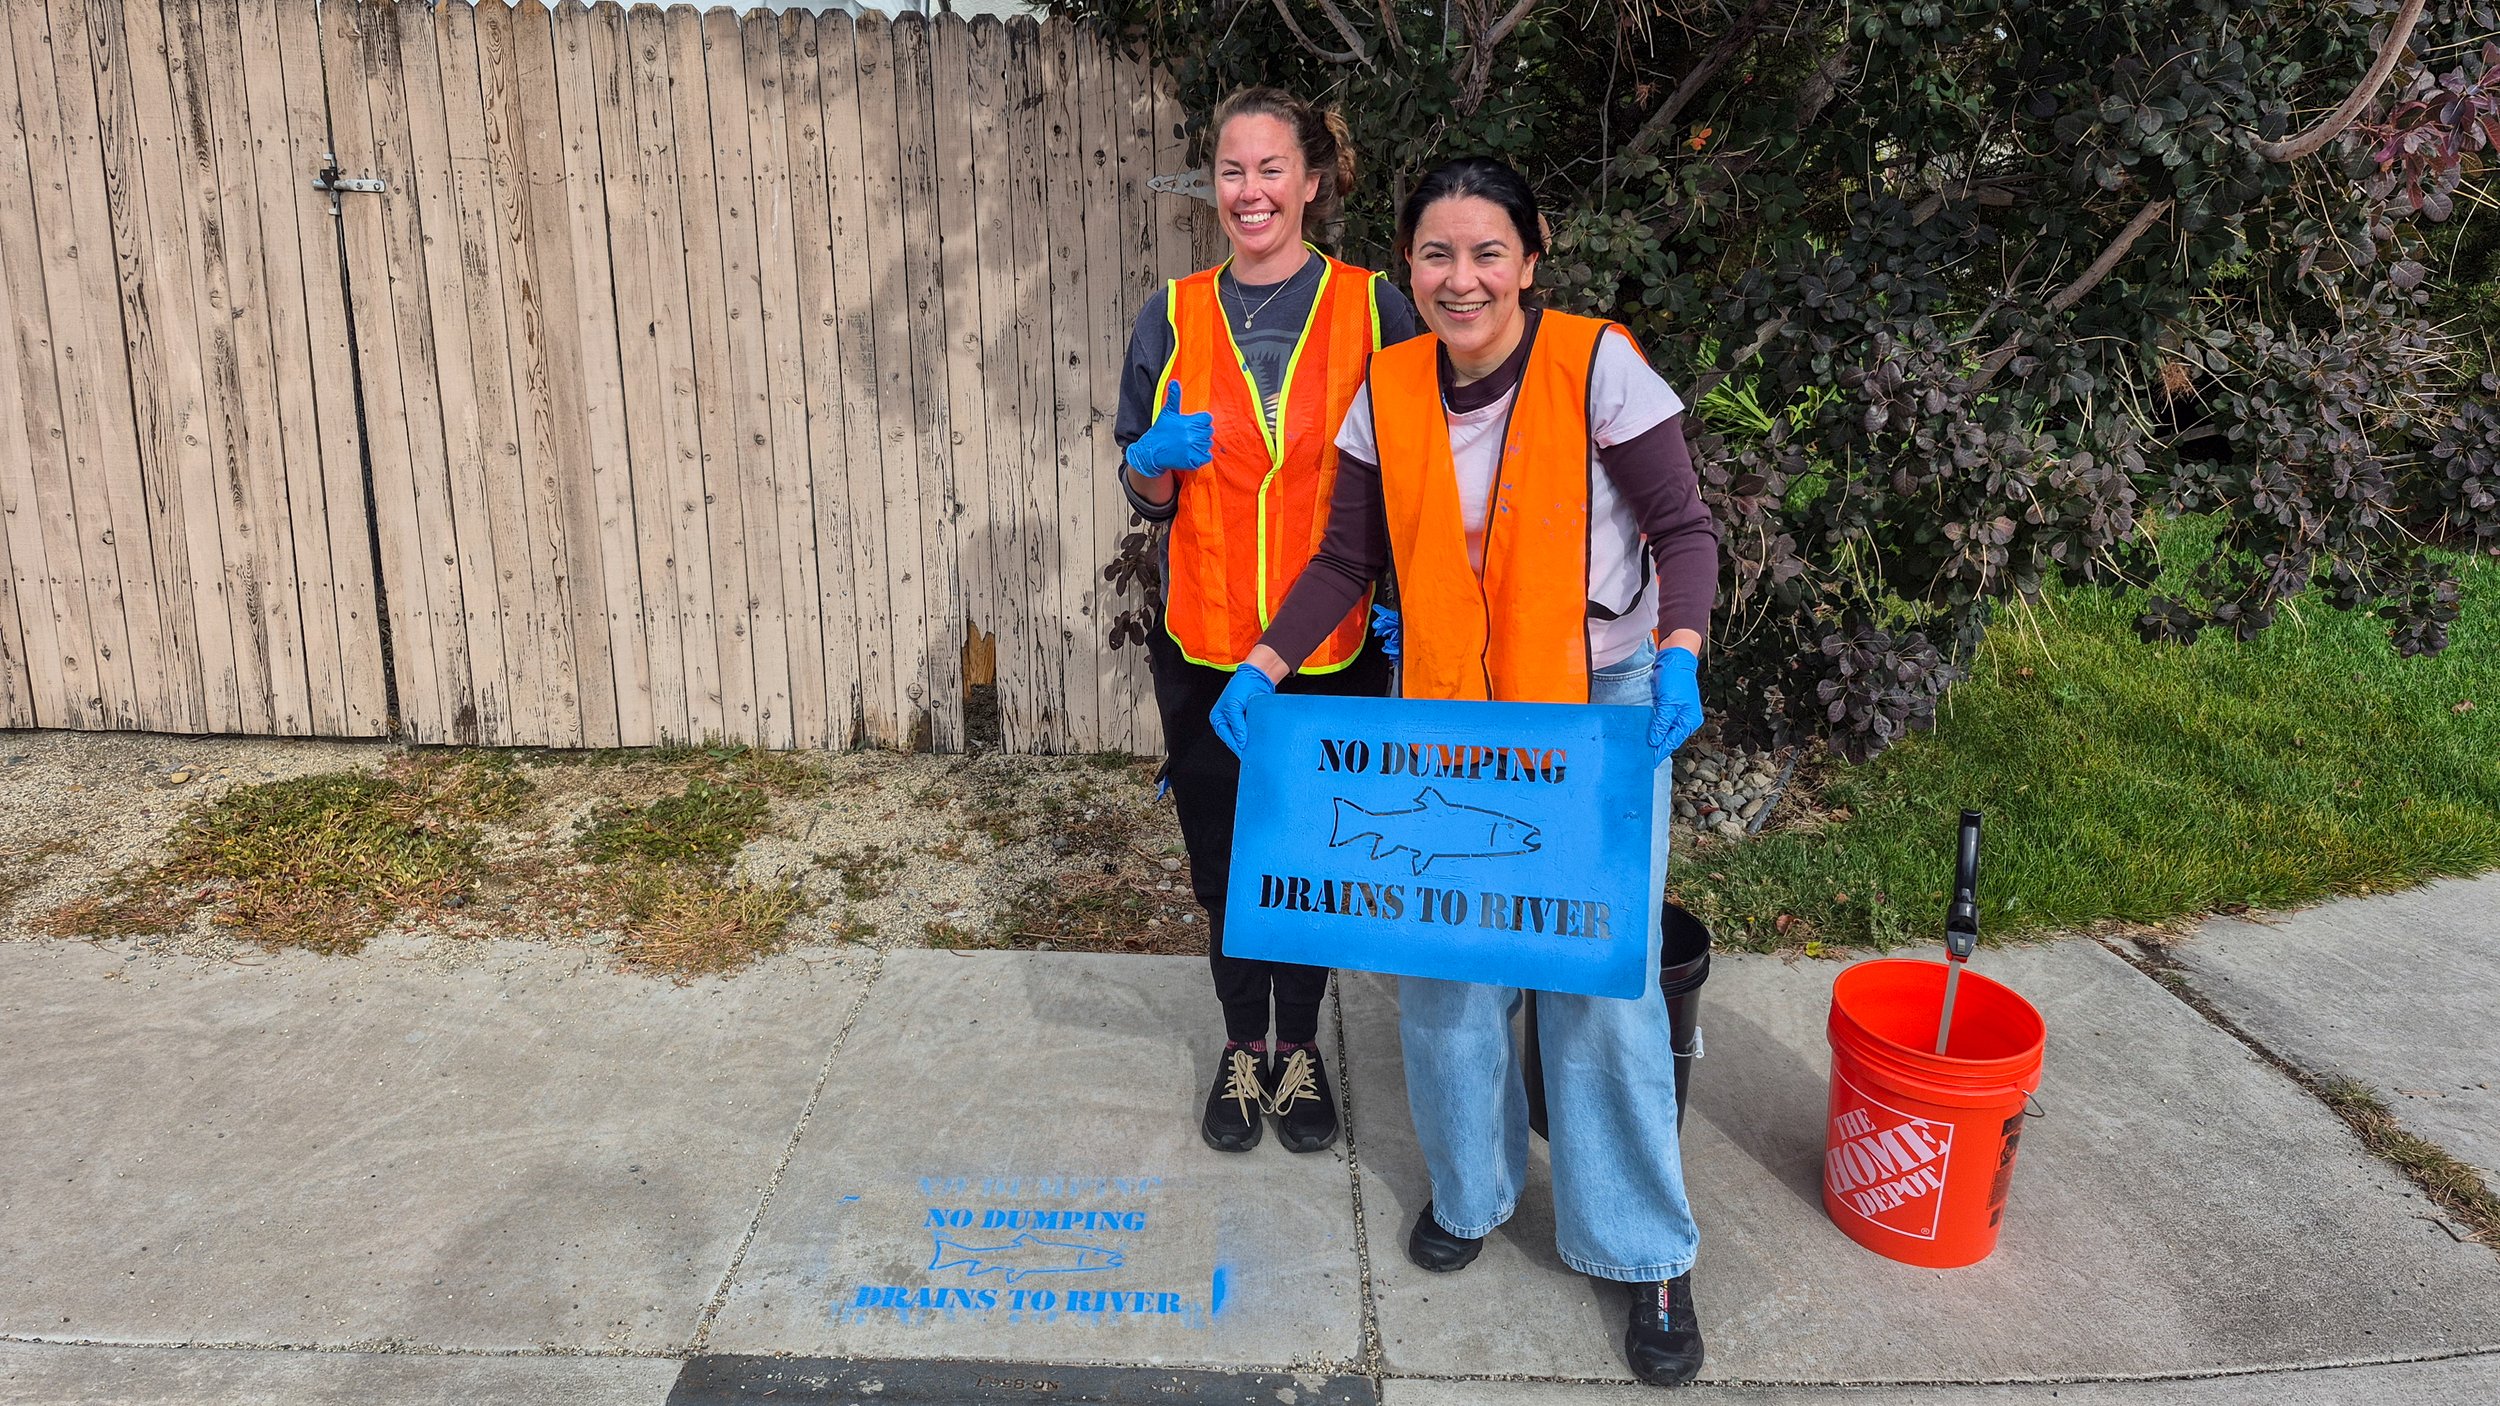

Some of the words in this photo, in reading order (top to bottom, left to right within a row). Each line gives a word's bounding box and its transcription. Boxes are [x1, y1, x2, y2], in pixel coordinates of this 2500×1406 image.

[1317, 739, 1370, 774] NO
[1379, 741, 1567, 785] DUMPING
[1259, 874, 1405, 920] DRAINS
[1416, 886, 1468, 927] TO
[1478, 892, 1612, 941] RIVER
[1834, 1107, 1878, 1140] THE
[1826, 1118, 1950, 1195] HOME
[1852, 1165, 1942, 1217] DEPOT
[923, 1208, 974, 1228] NO
[981, 1210, 1148, 1232] DUMPING
[853, 1285, 1000, 1312] DRAINS
[1008, 1288, 1055, 1312] TO
[1066, 1290, 1182, 1315] RIVER
